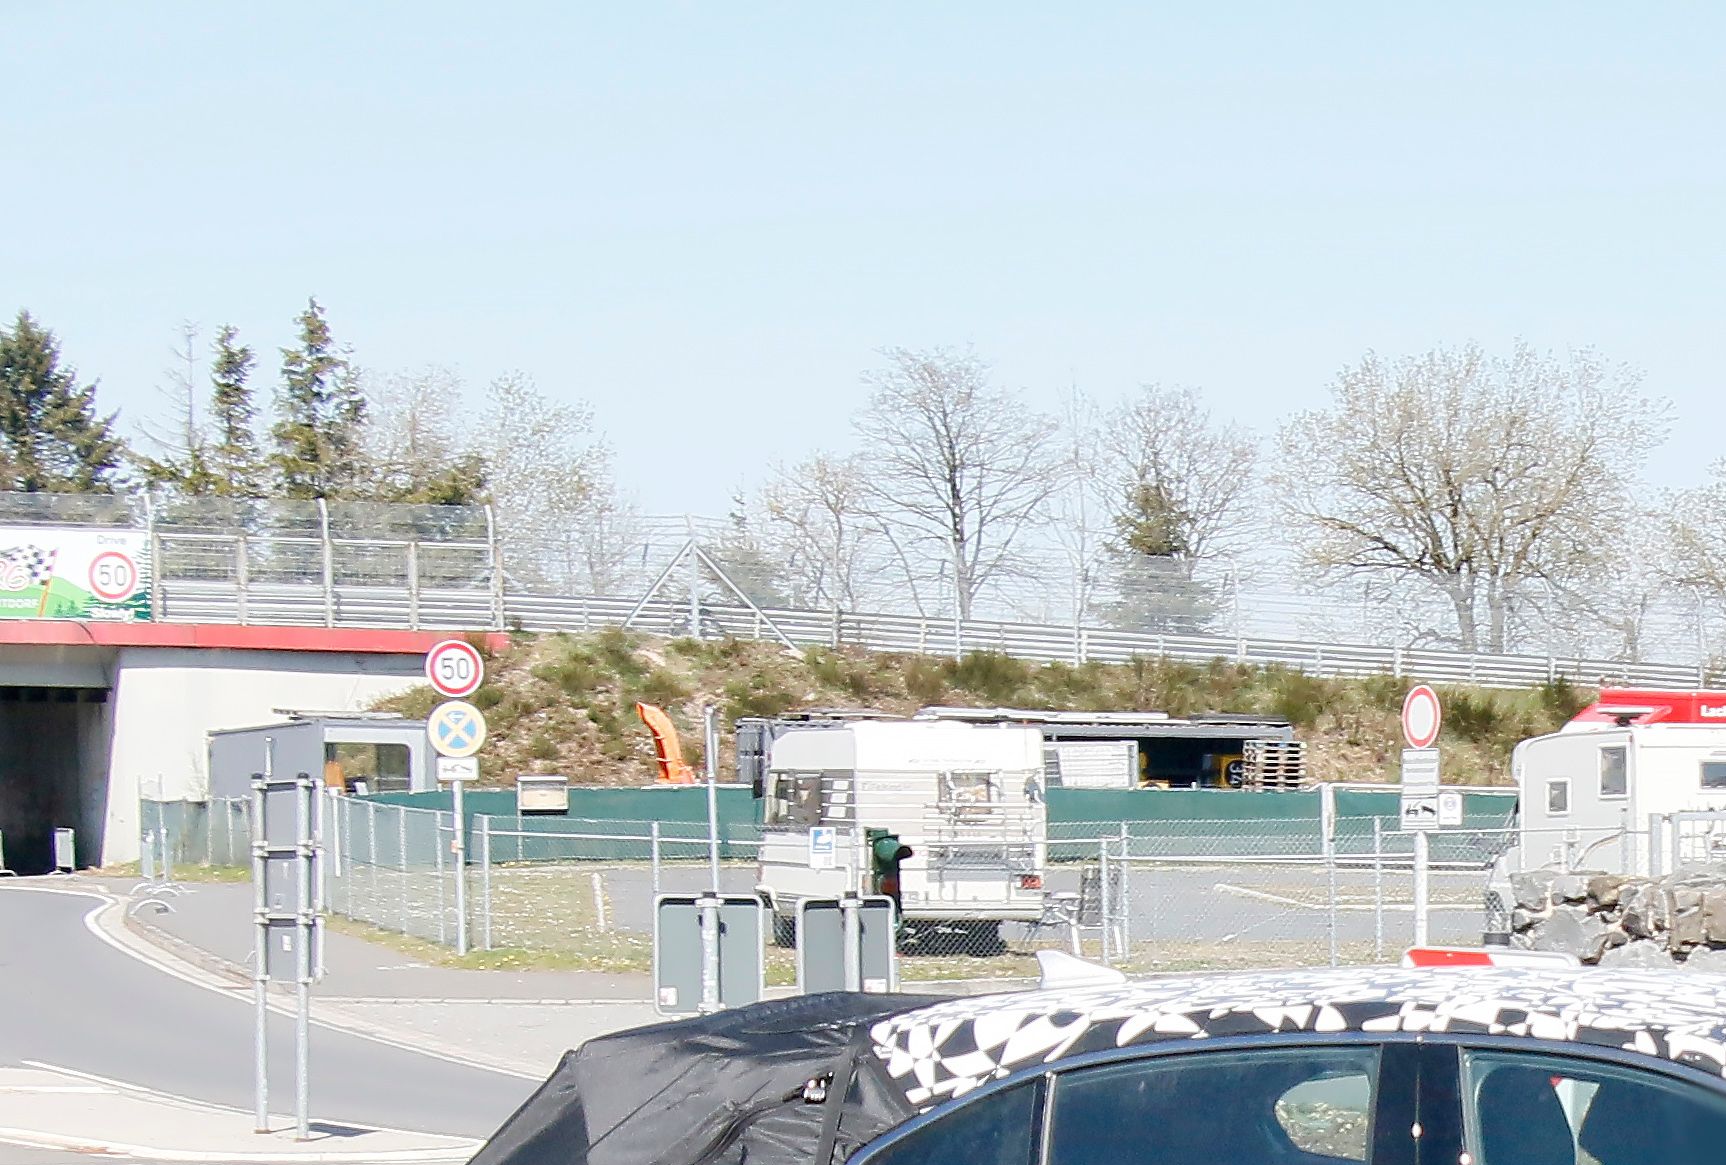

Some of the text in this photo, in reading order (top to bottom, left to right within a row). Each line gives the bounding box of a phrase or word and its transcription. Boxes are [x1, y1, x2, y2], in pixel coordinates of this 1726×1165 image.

[97, 534, 127, 545] Drive
[100, 564, 127, 587] 50
[441, 657, 469, 680] 50
